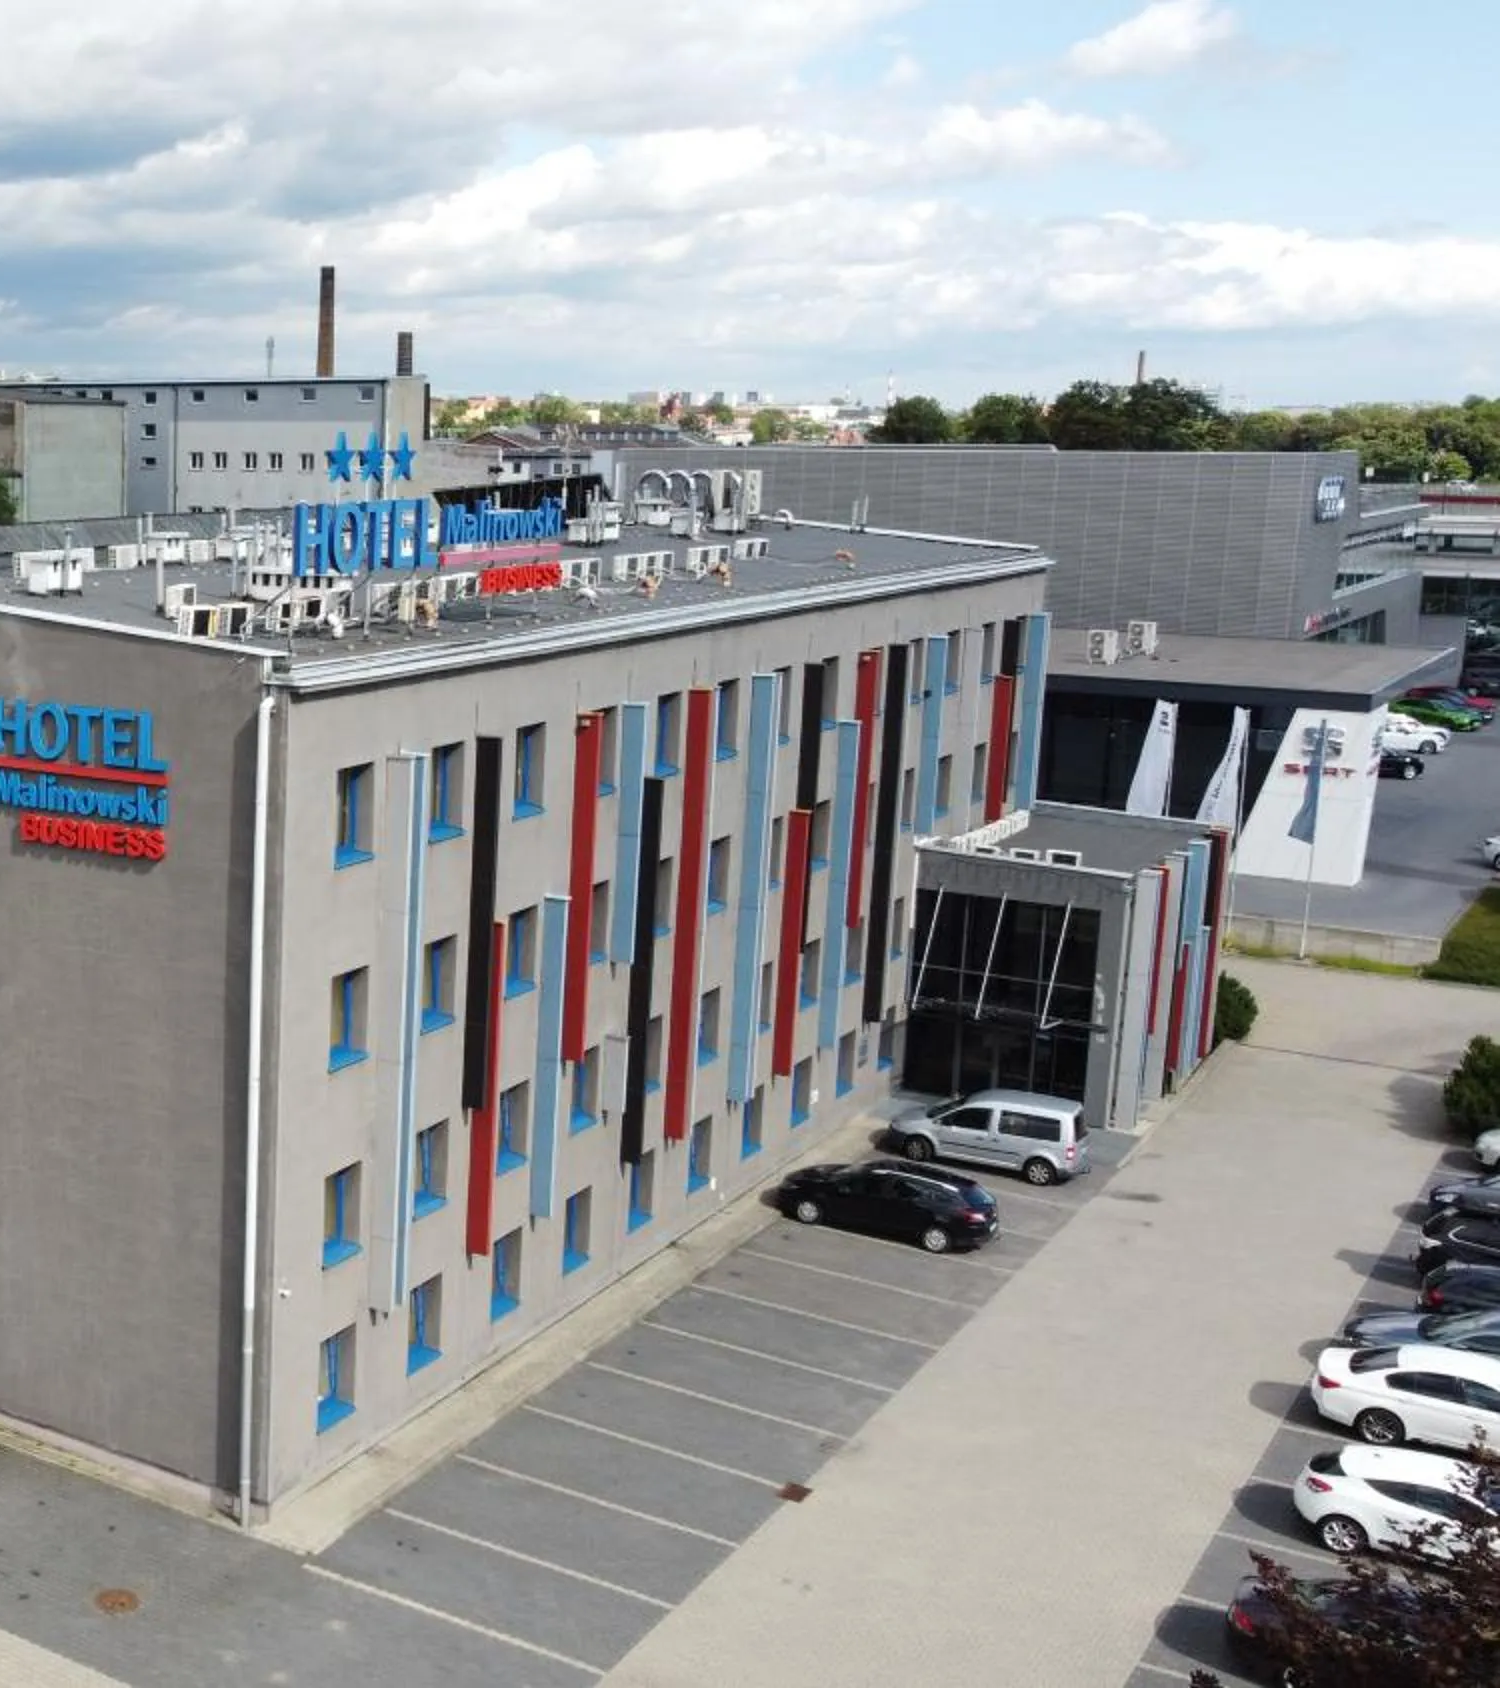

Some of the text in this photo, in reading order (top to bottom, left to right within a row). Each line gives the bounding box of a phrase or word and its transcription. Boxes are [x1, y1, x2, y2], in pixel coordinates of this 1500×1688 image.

[293, 499, 437, 577] HOTEL
[442, 496, 562, 545] Malinowski
[480, 562, 562, 594] BUSINESS
[20, 811, 167, 861] BUSINESS
